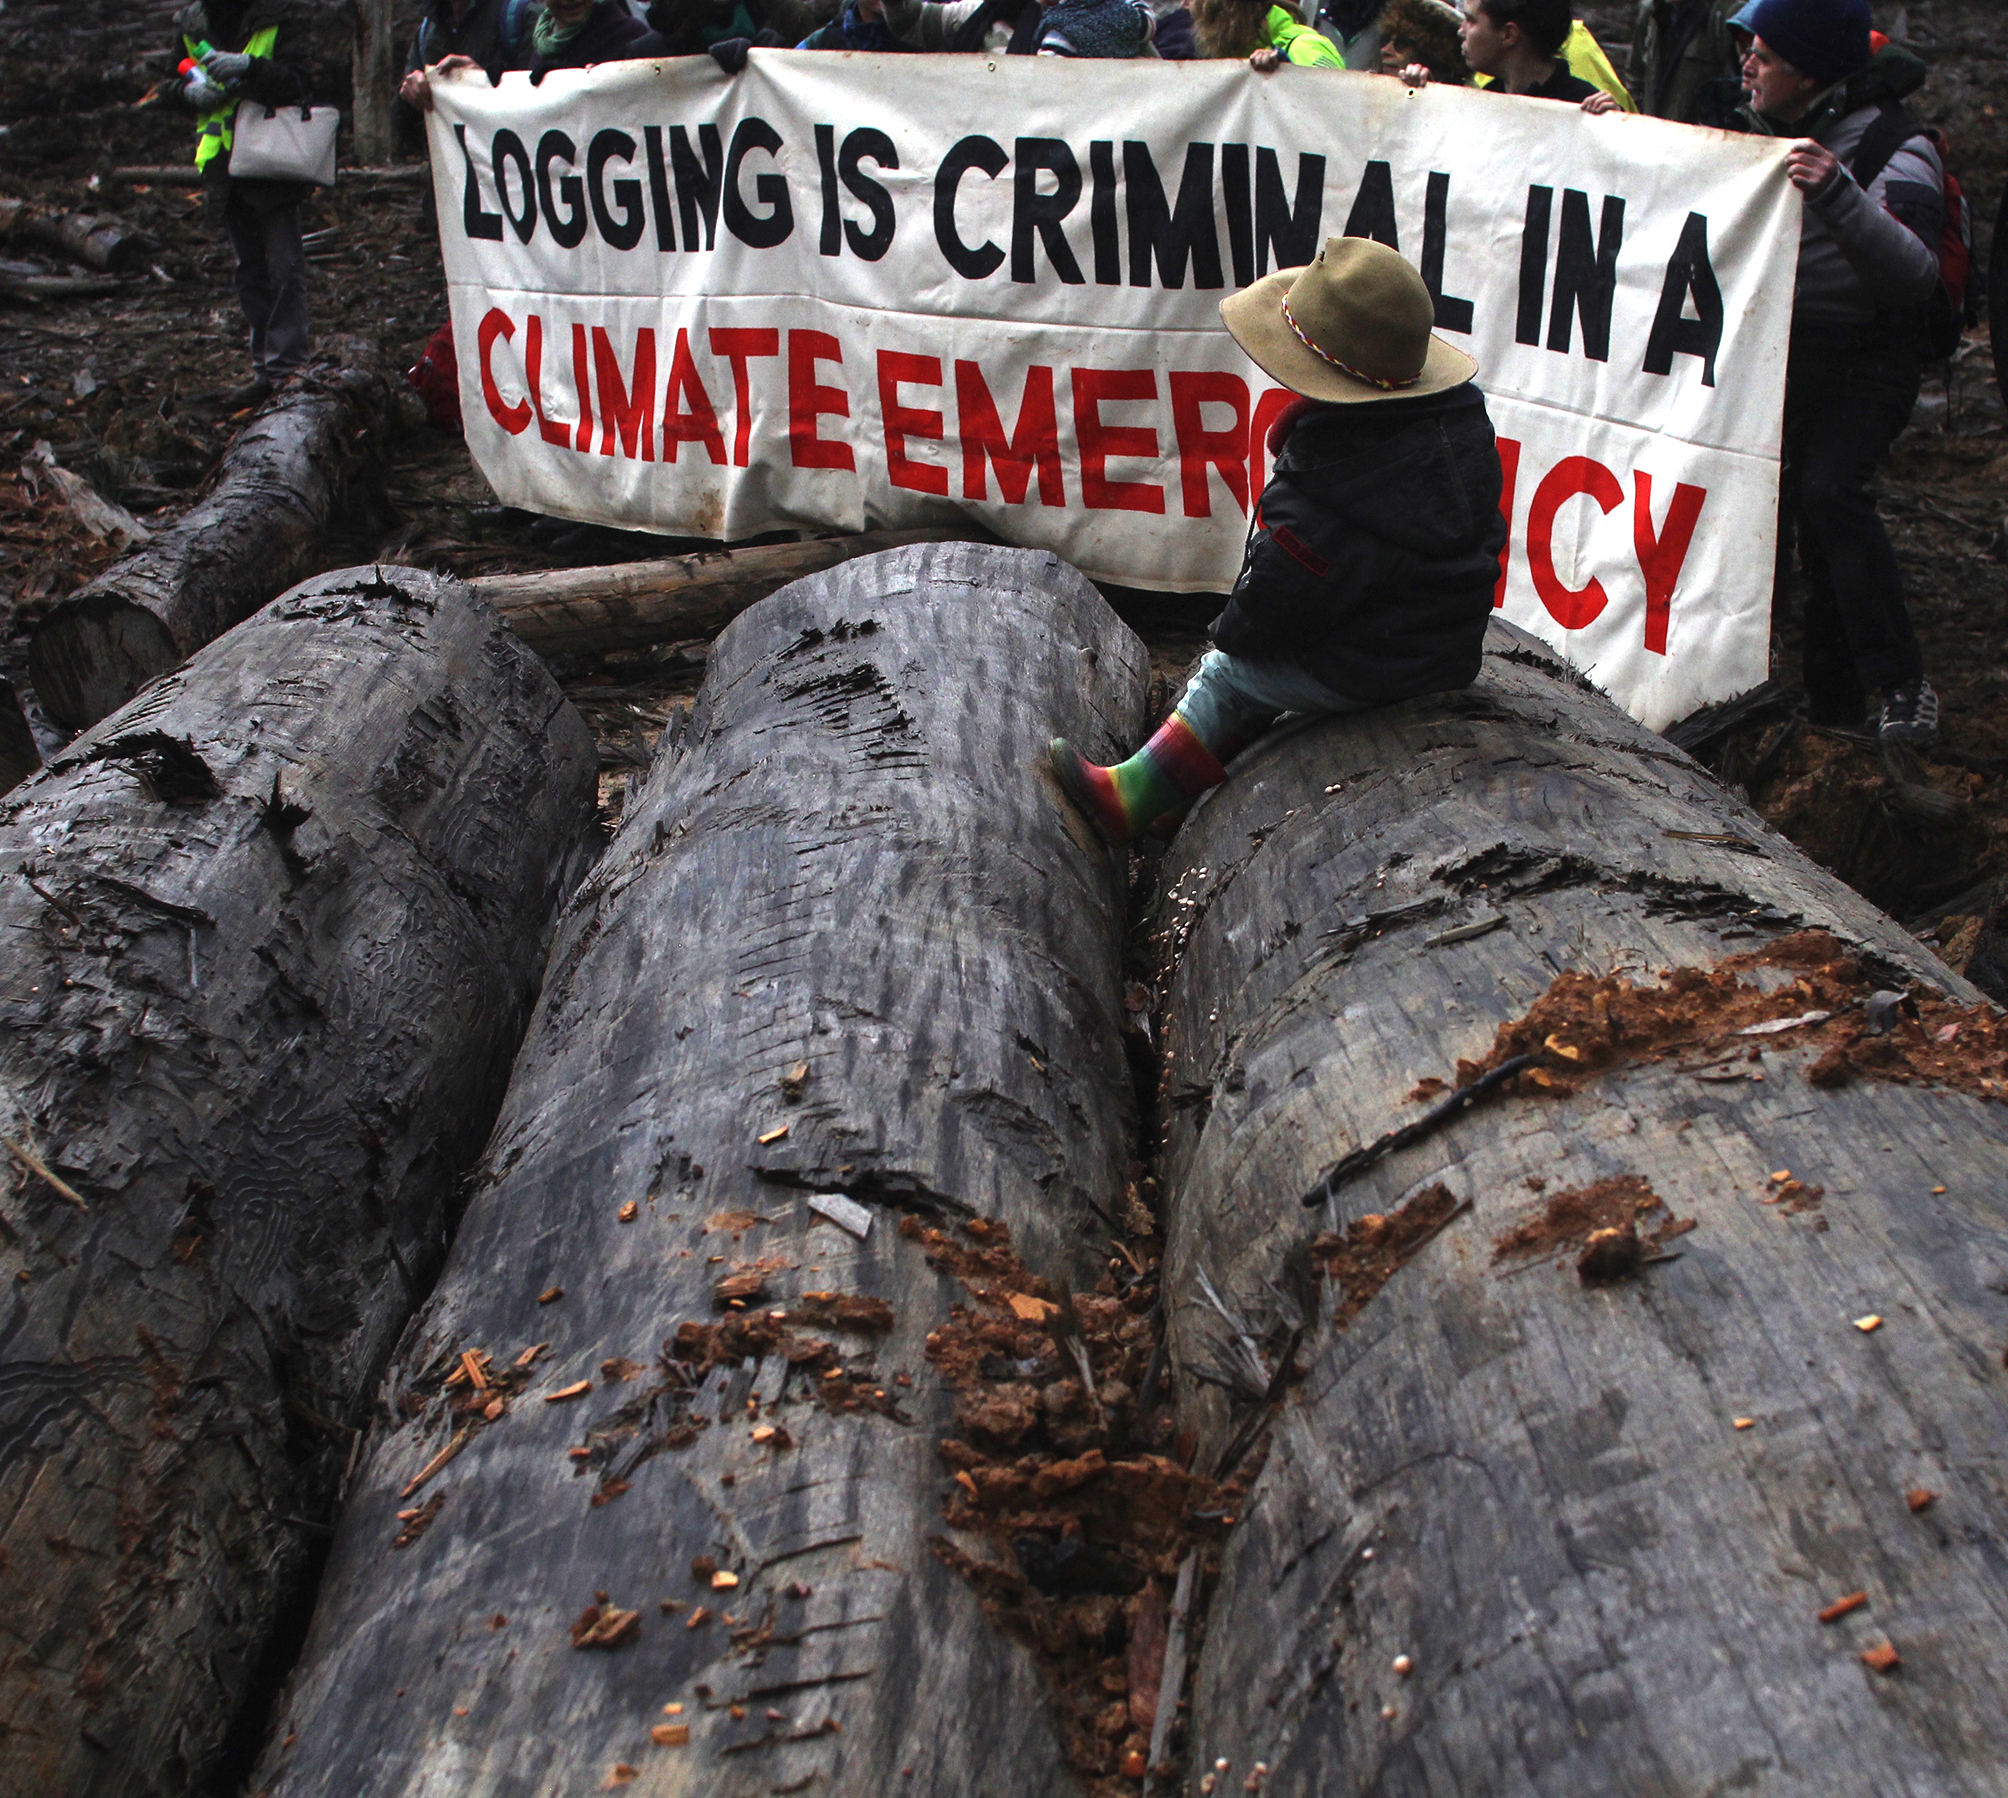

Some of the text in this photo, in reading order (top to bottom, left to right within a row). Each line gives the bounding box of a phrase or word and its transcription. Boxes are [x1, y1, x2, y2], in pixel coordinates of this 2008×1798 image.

[453, 117, 795, 252] LOGGING
[813, 123, 900, 262] IS
[1515, 184, 1626, 362] IN
[1642, 211, 1724, 388] A
[477, 307, 1707, 656] CLIMATE EMERCY
